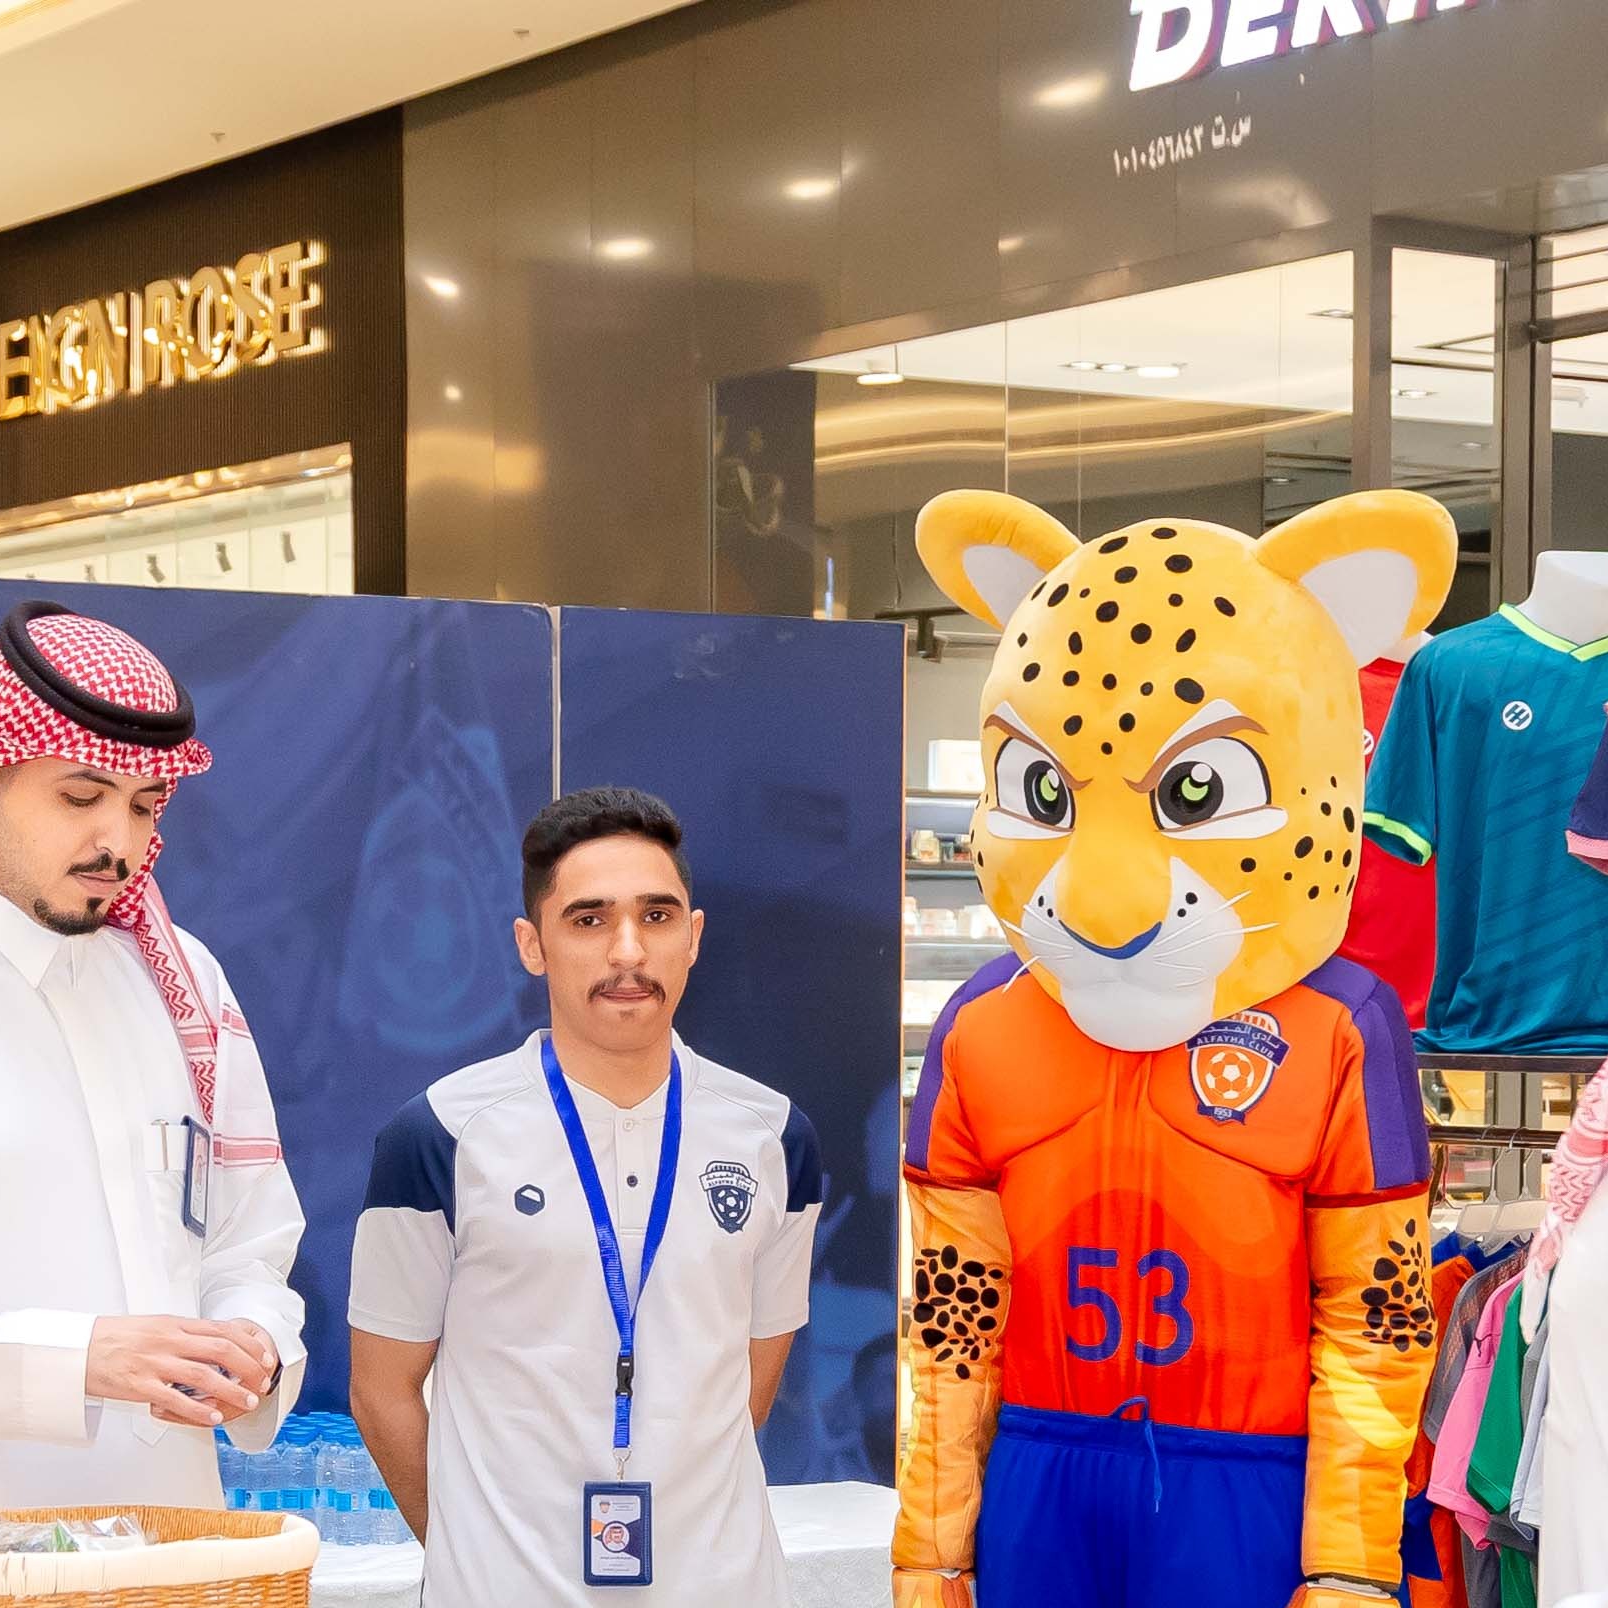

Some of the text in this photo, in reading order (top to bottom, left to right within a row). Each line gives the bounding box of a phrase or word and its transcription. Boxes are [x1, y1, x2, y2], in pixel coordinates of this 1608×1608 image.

[144, 240, 317, 388] ROSE
[1196, 1035, 1275, 1059] ALFAYHA CLUB
[1213, 1106, 1233, 1118] 1953
[1066, 1246, 1194, 1367] 53
